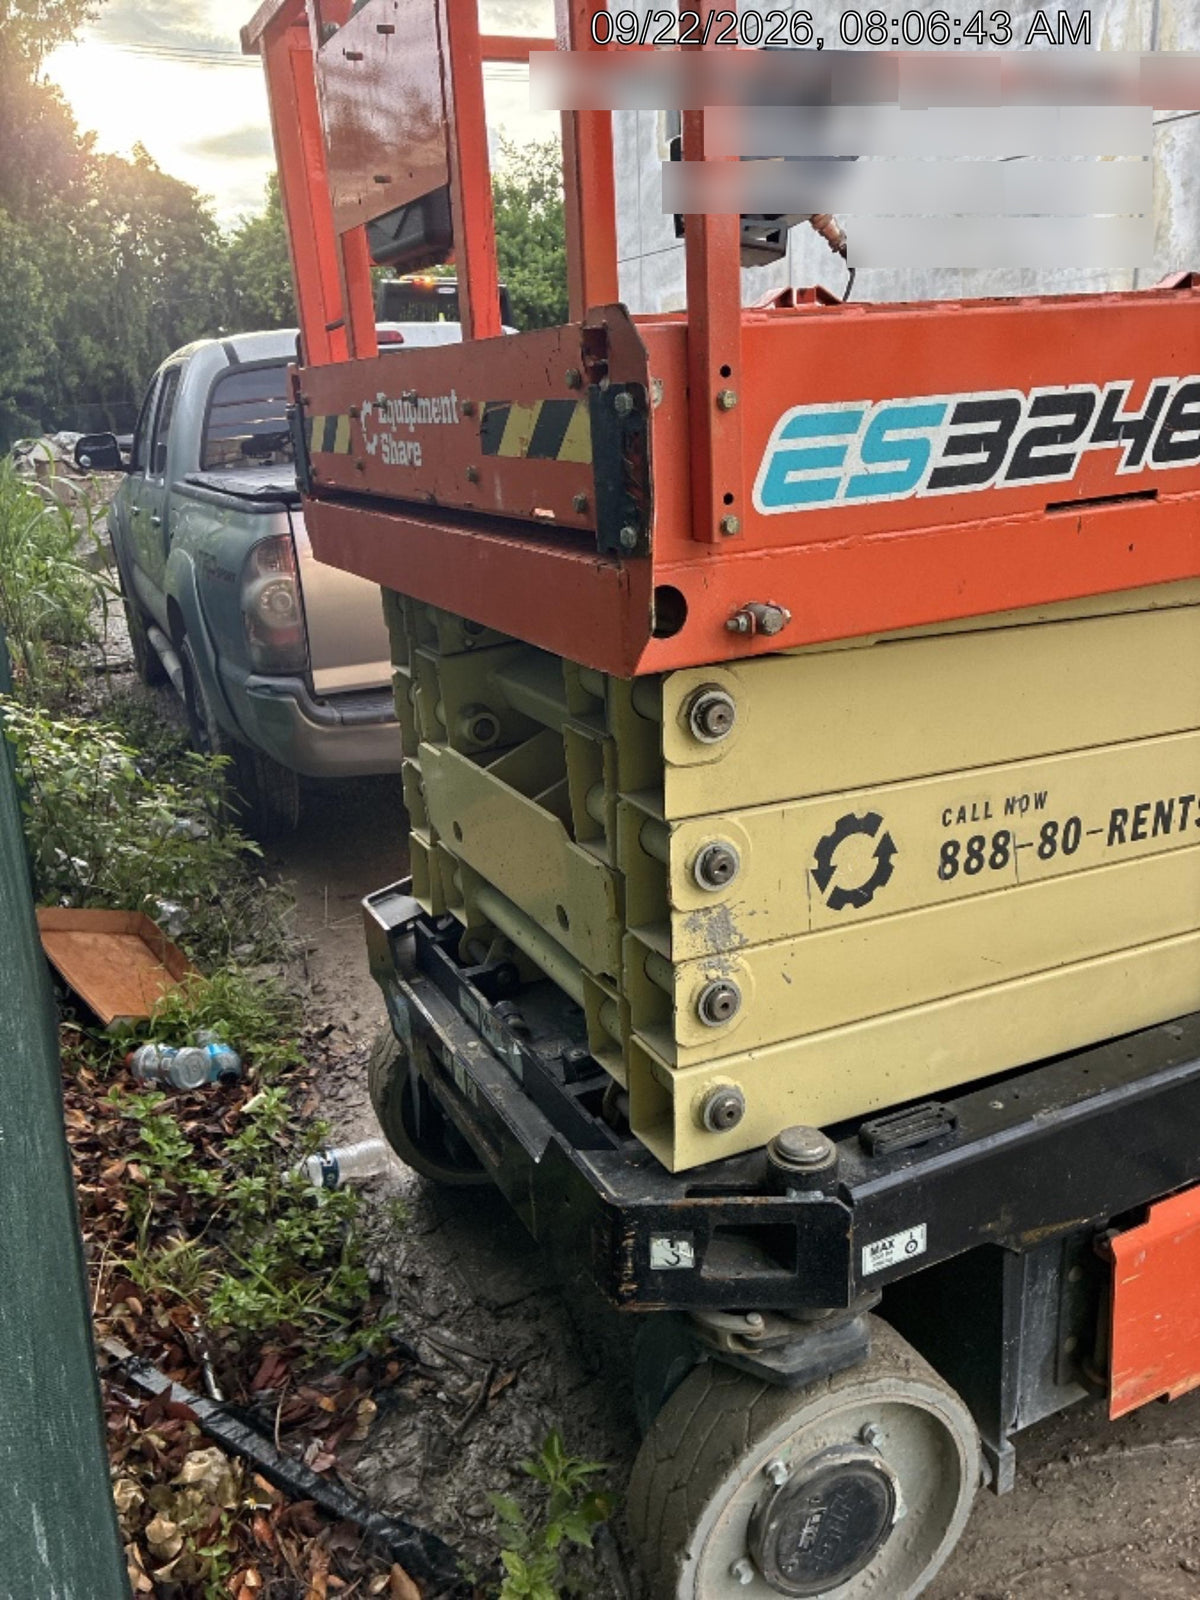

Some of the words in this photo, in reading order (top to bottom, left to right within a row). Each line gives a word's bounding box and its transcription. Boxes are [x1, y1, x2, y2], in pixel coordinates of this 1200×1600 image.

[376, 389, 459, 432] Equipment
[380, 433, 422, 467] Share
[942, 801, 993, 827] CALL
[1004, 790, 1048, 816] NOW
